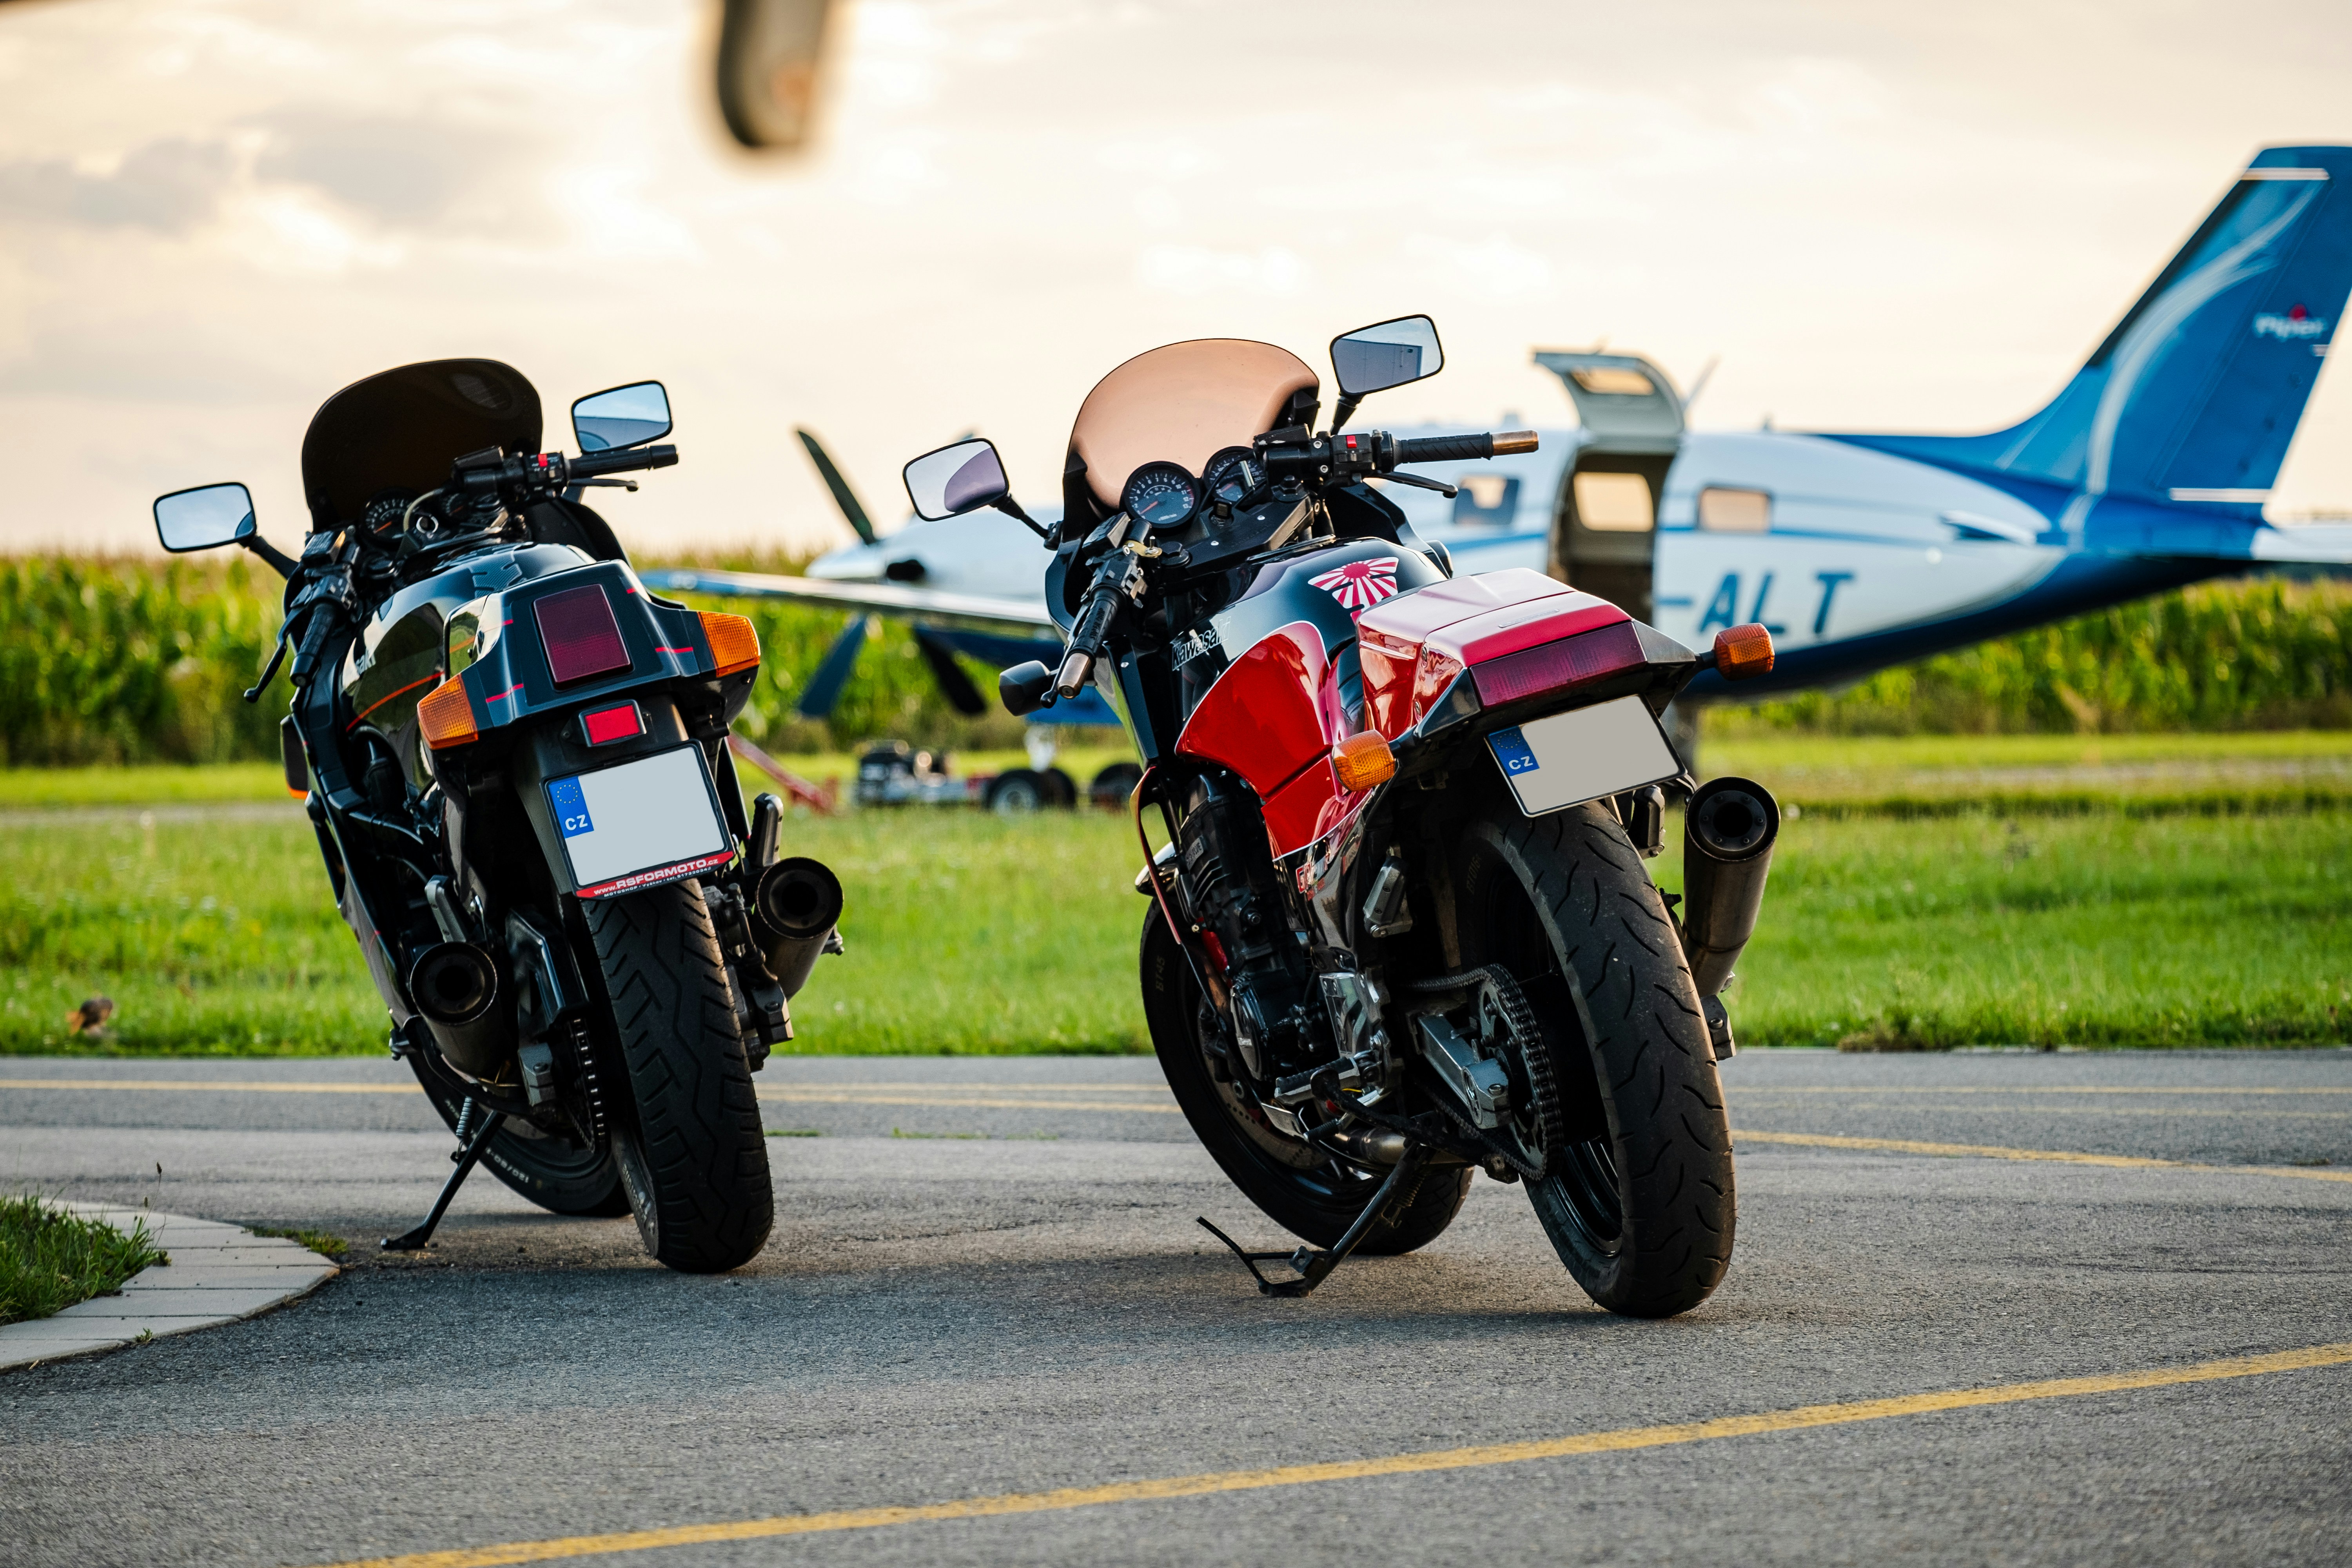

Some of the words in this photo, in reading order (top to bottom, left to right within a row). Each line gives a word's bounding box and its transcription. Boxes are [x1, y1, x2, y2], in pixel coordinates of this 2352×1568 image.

[1172, 616, 1231, 671] Kawasaki
[1508, 755, 1534, 770] CZ
[564, 814, 588, 831] CZ
[593, 859, 719, 895] www.RSFORMOTO.cz
[604, 886, 638, 897] MOTOSHOP
